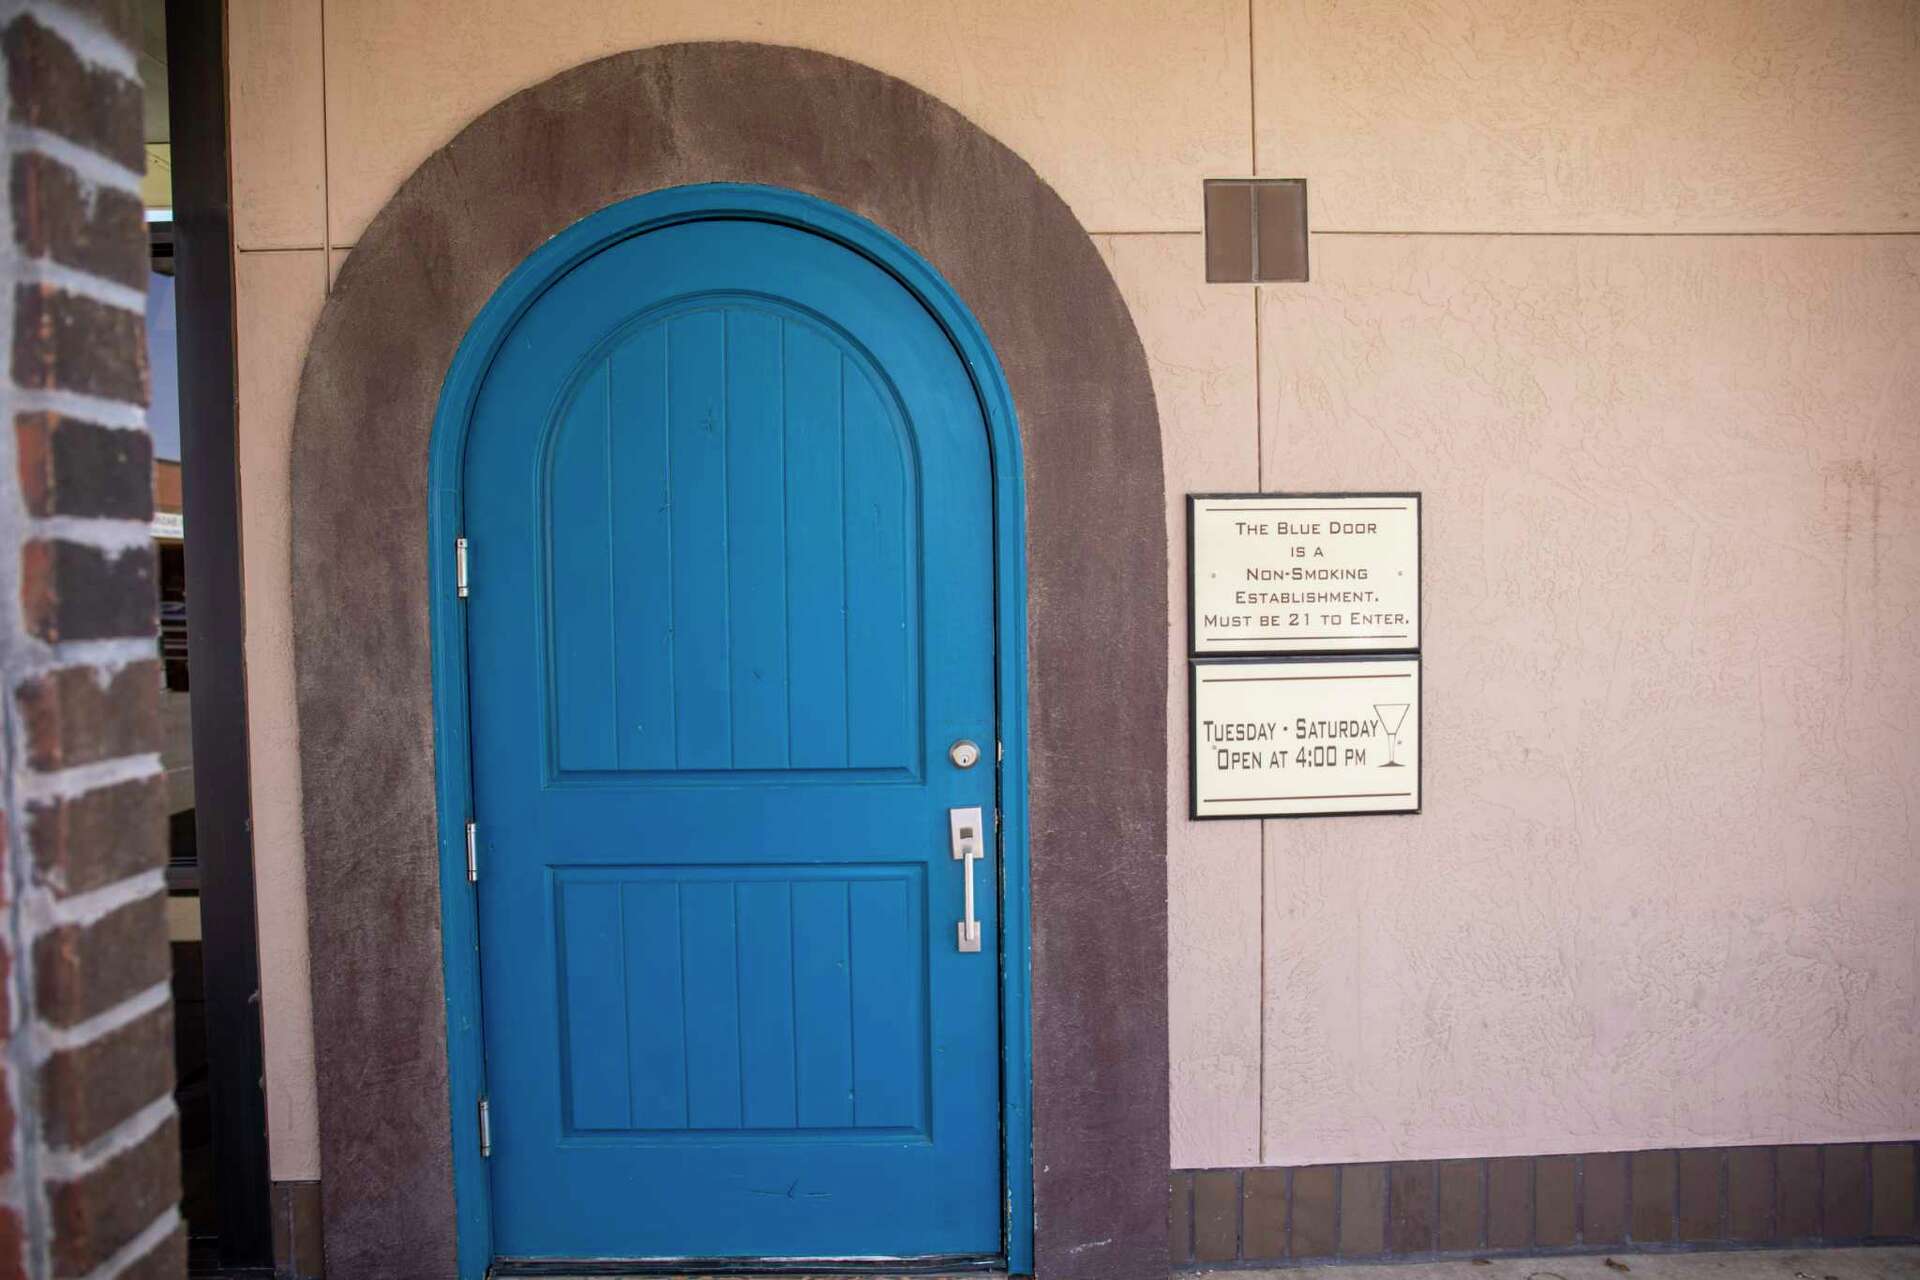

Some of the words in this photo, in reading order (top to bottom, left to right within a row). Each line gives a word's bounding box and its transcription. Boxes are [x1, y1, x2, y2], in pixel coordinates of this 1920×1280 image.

[1235, 522, 1268, 535] THE
[1278, 522, 1320, 534] BLUE
[1330, 522, 1377, 534] DOOR
[1291, 547, 1305, 557] IS
[1314, 547, 1324, 557] A
[1236, 591, 1379, 604] ESTABLISHMENT.
[1204, 614, 1252, 626] MUST
[1260, 615, 1280, 626] BE
[1289, 613, 1309, 626] 21
[1321, 614, 1341, 625] TO
[1351, 613, 1409, 624] ENTER.
[1203, 721, 1276, 741] TUESDAY
[1296, 718, 1379, 738] SATURDAY
[1218, 749, 1261, 769] OPEN
[1270, 751, 1288, 768] AT
[1296, 746, 1336, 767] 4:00
[1345, 749, 1365, 766] PM
